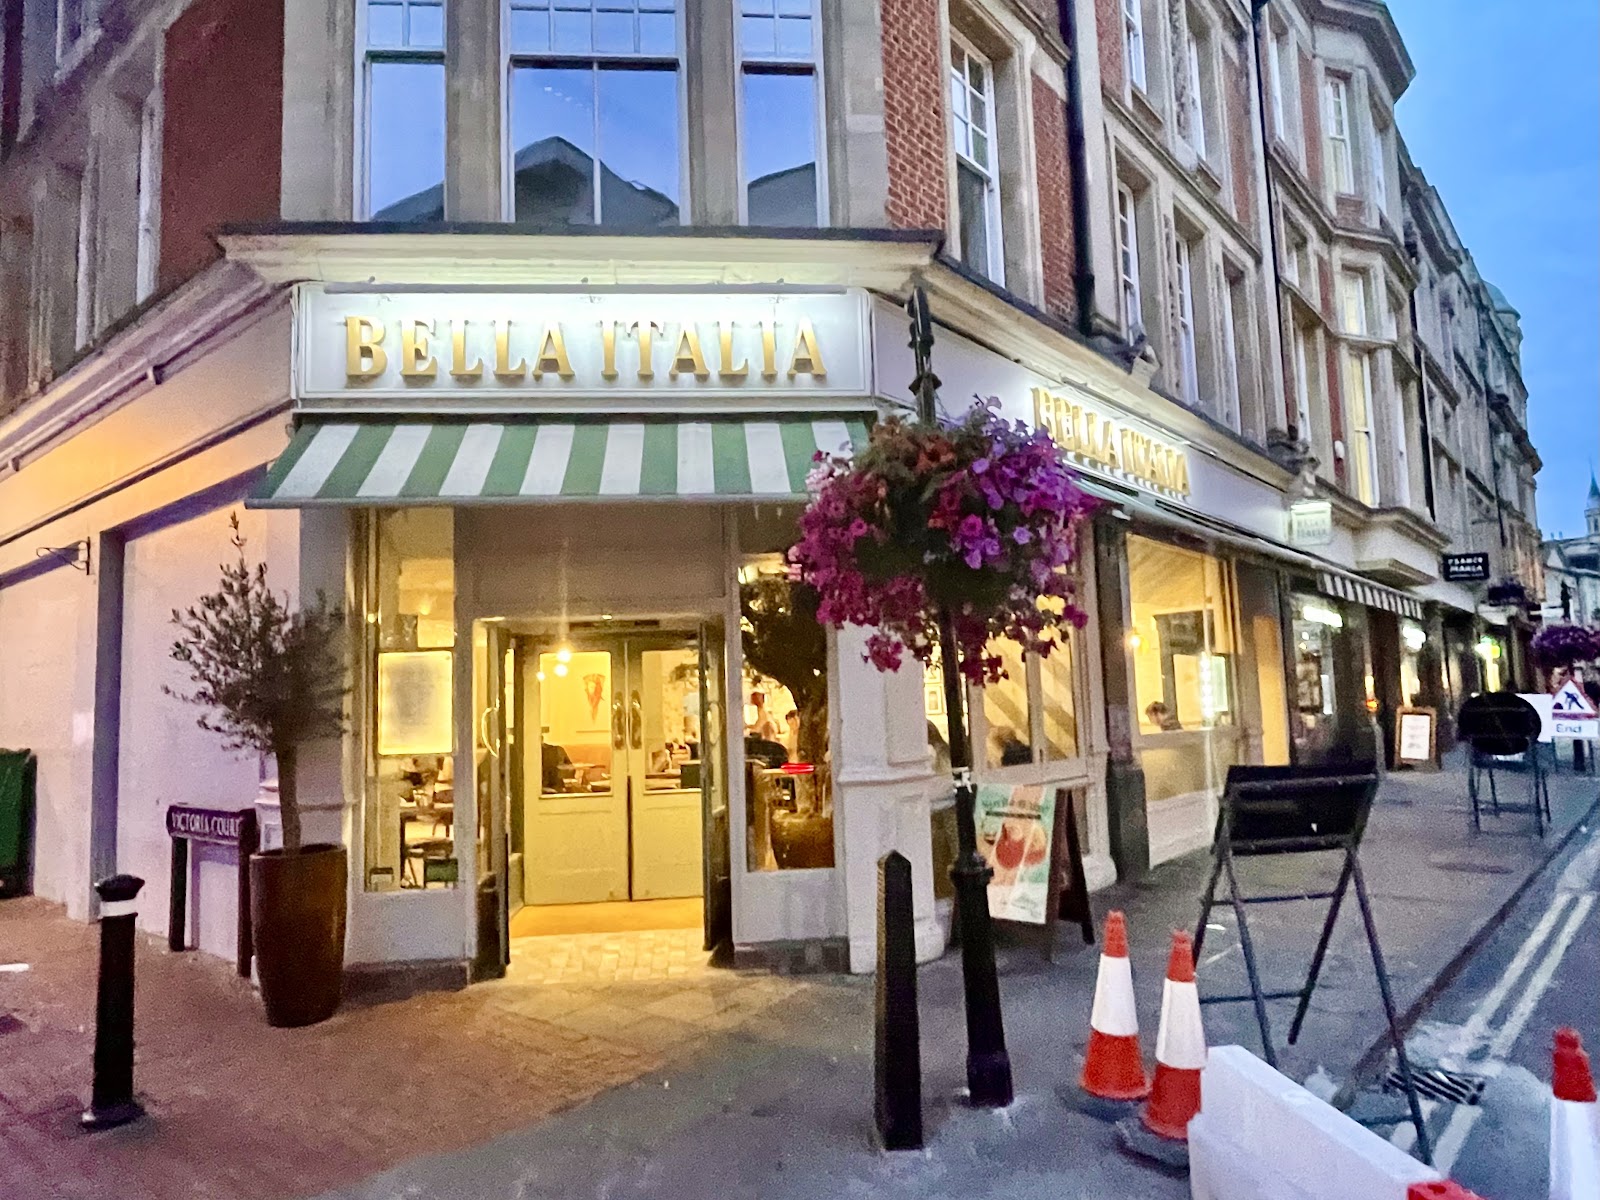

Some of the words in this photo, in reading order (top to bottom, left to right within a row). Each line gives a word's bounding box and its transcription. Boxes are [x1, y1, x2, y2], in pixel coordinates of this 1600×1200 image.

[344, 315, 576, 377] BELLA
[600, 315, 828, 377] ITALIA
[1030, 387, 1121, 469] BELLA
[1119, 428, 1191, 497] ITALIA
[1556, 723, 1582, 733] End
[171, 811, 210, 832] VICTORIA
